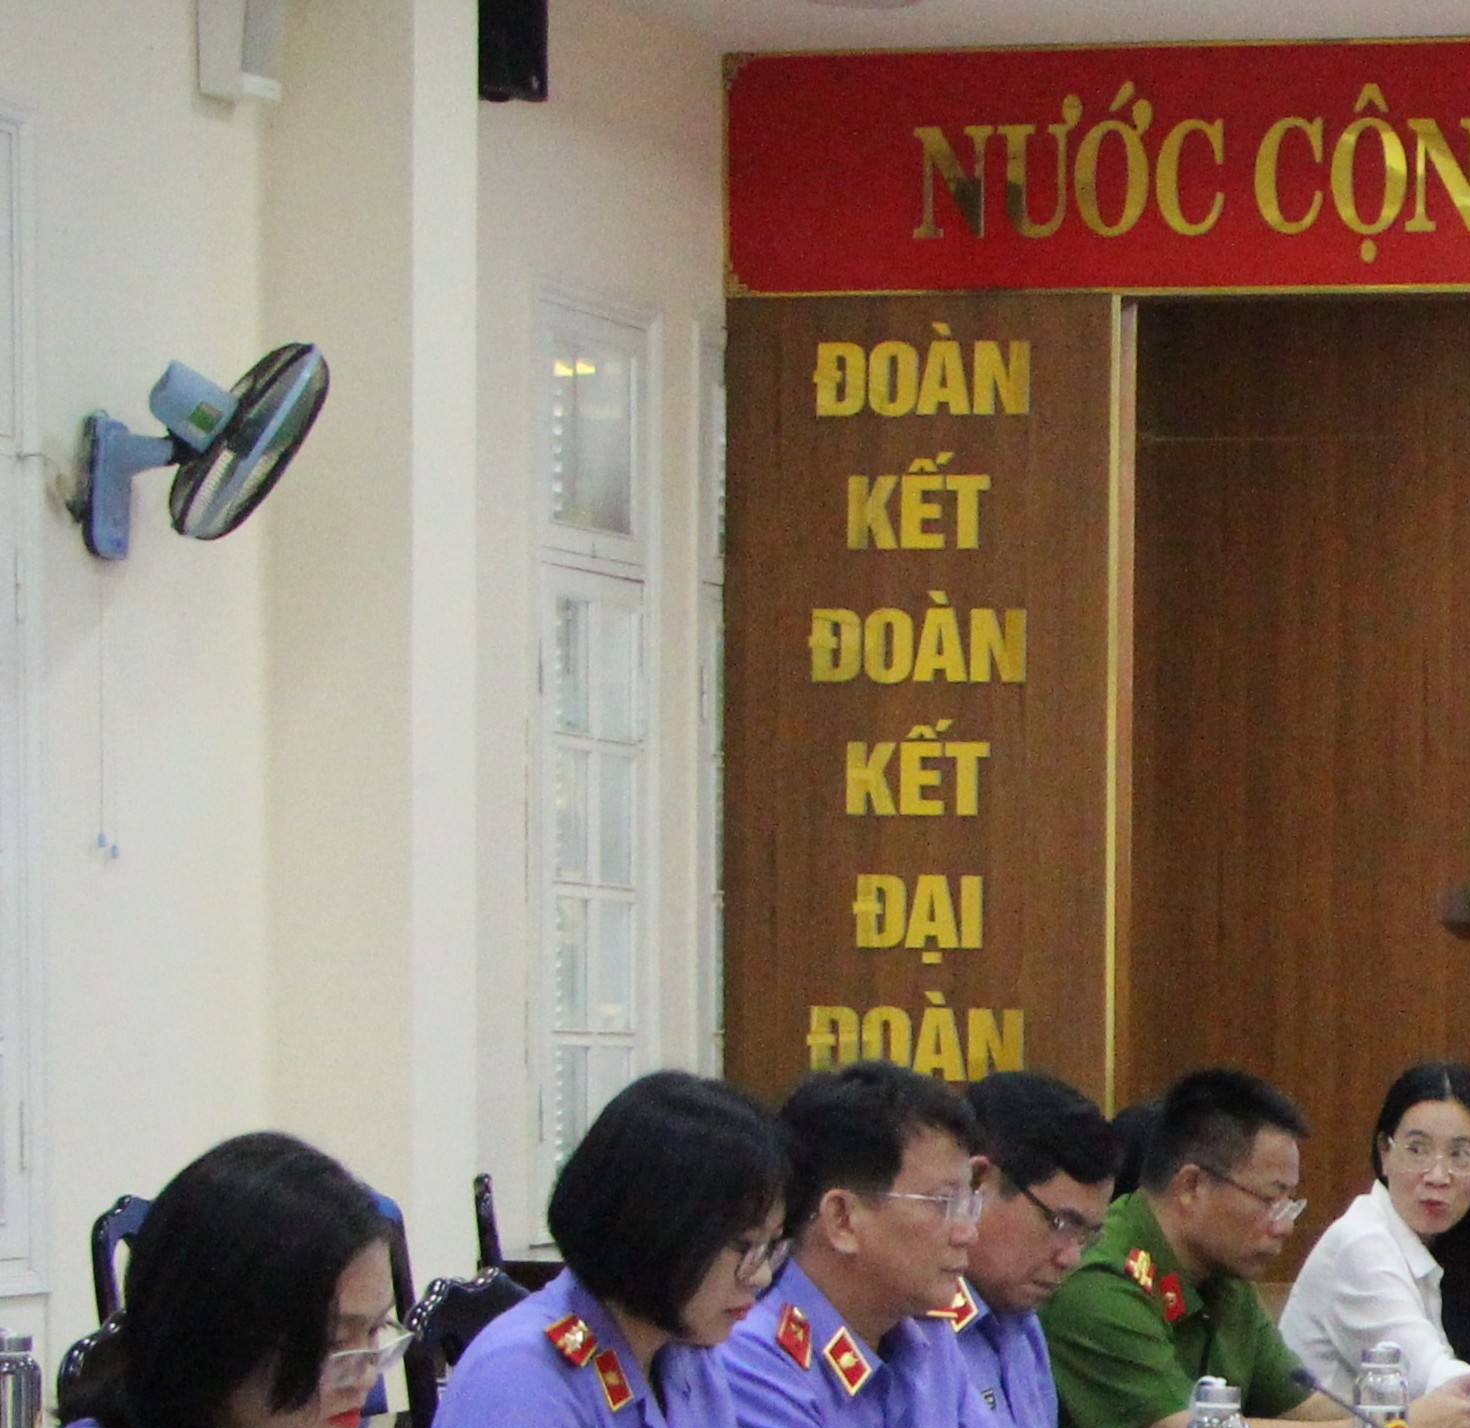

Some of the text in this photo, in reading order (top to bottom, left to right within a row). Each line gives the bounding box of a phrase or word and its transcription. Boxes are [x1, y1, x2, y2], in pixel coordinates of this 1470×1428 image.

[913, 81, 1225, 239] NƯỚC
[812, 322, 1030, 417] ĐOÀN
[847, 452, 991, 550] KẾT
[808, 590, 1027, 683] ĐOÀN
[846, 719, 990, 816] KẾT
[853, 874, 983, 964] ĐẠI
[807, 991, 1024, 1082] ĐOÀN
